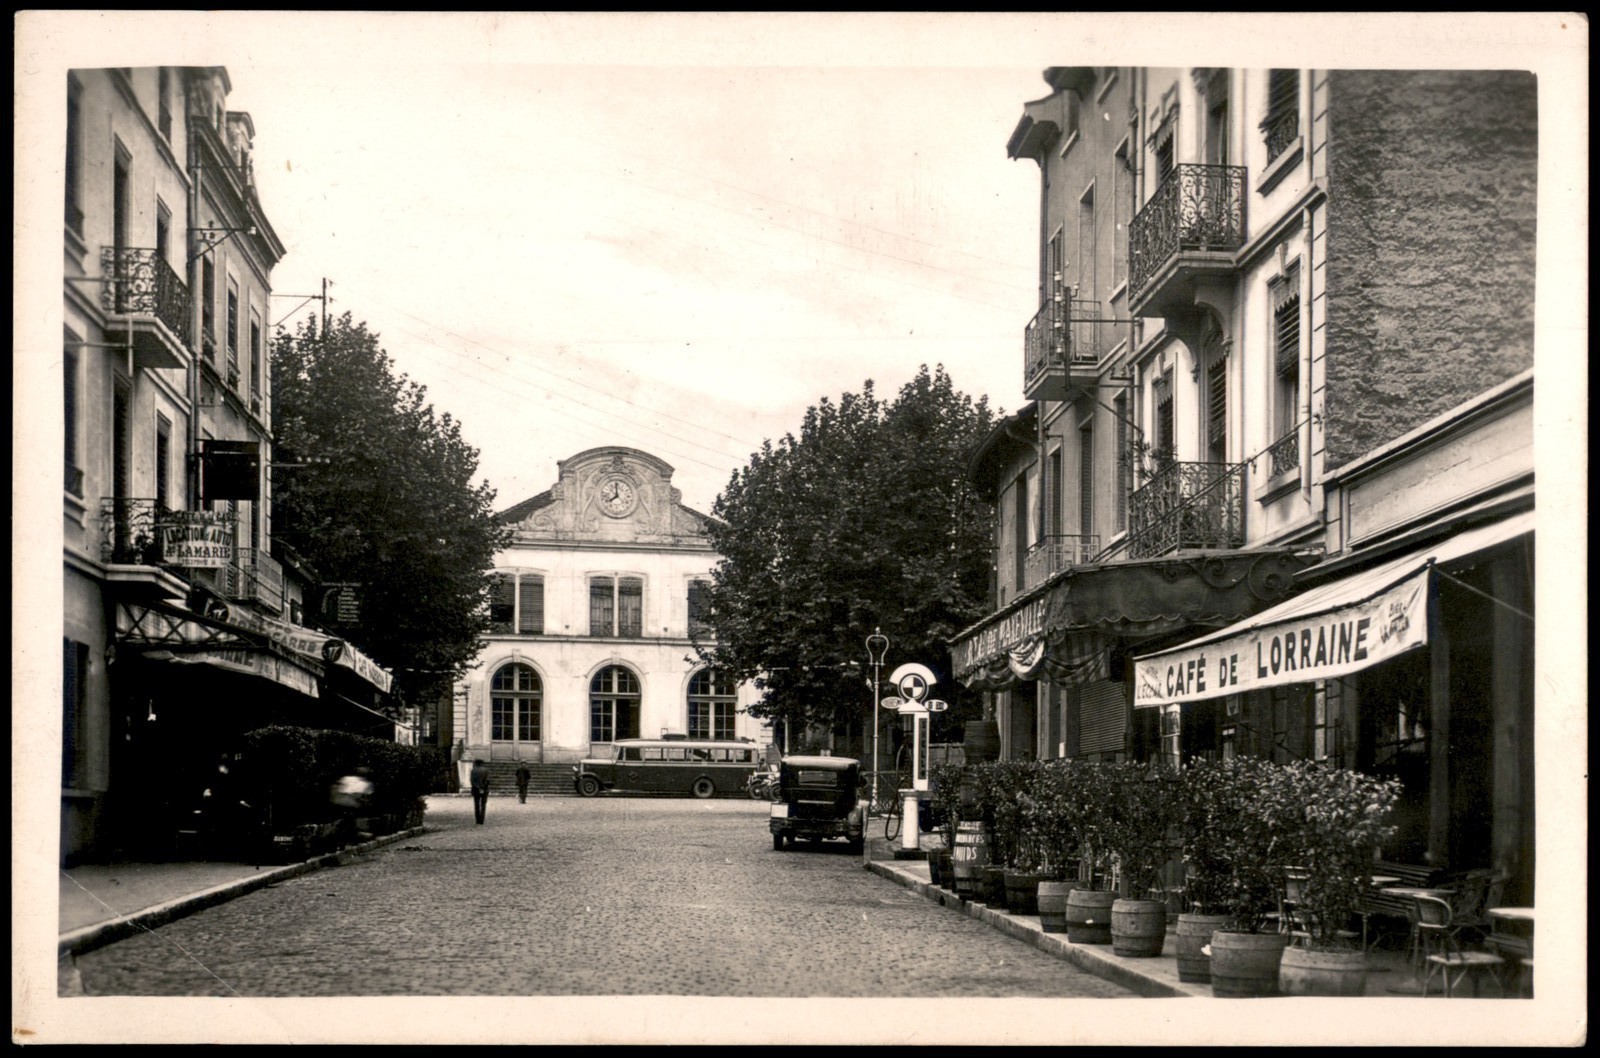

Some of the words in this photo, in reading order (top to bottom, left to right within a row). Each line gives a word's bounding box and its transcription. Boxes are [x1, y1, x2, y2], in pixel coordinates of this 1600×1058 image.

[178, 546, 231, 559] LAMARIE
[1167, 652, 1206, 697] CAFÉ
[1219, 653, 1238, 688] DE
[1257, 617, 1371, 678] LORRAINE
